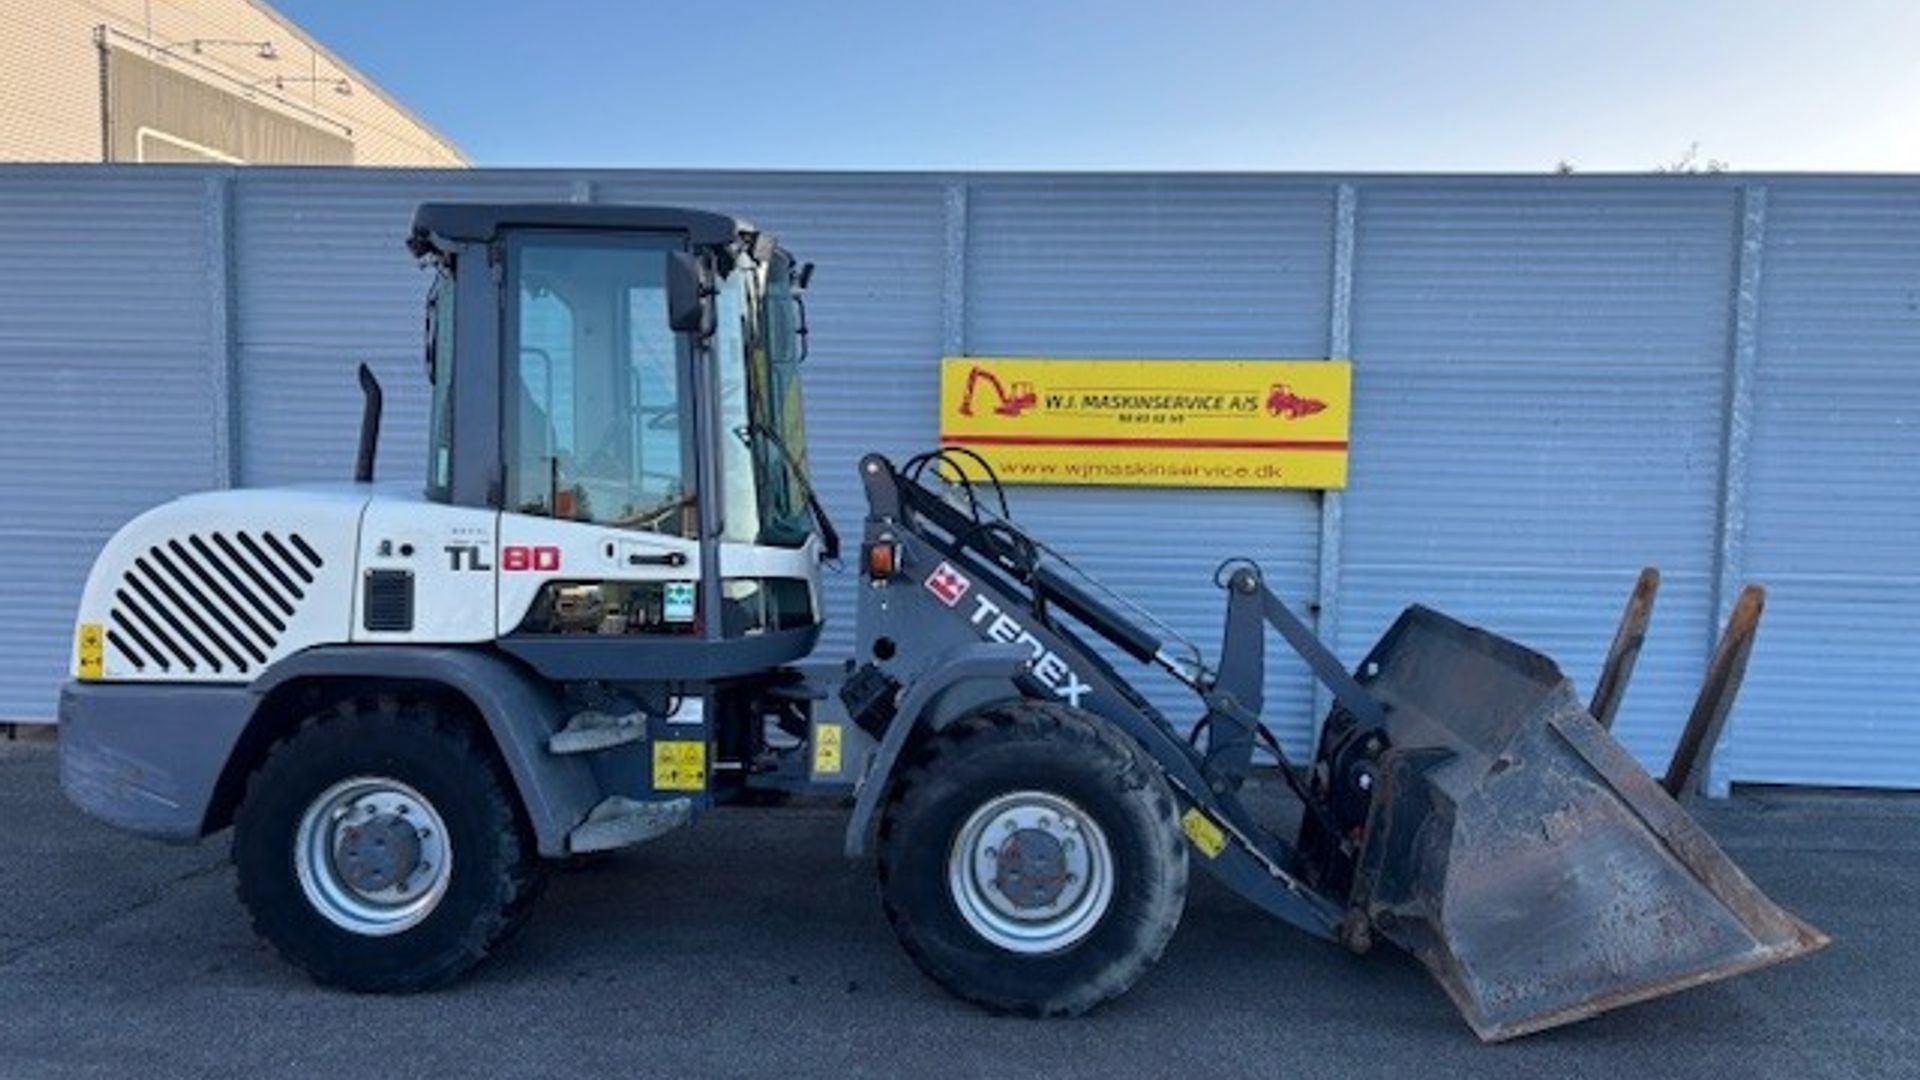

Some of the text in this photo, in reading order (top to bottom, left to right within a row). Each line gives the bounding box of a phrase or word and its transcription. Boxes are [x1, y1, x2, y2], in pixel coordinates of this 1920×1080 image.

[1044, 395, 1259, 412] W.J. MASKINSERVICE A/S
[1000, 463, 1283, 479] www.wjmaskinservice.dk
[444, 546, 560, 571] TL 80
